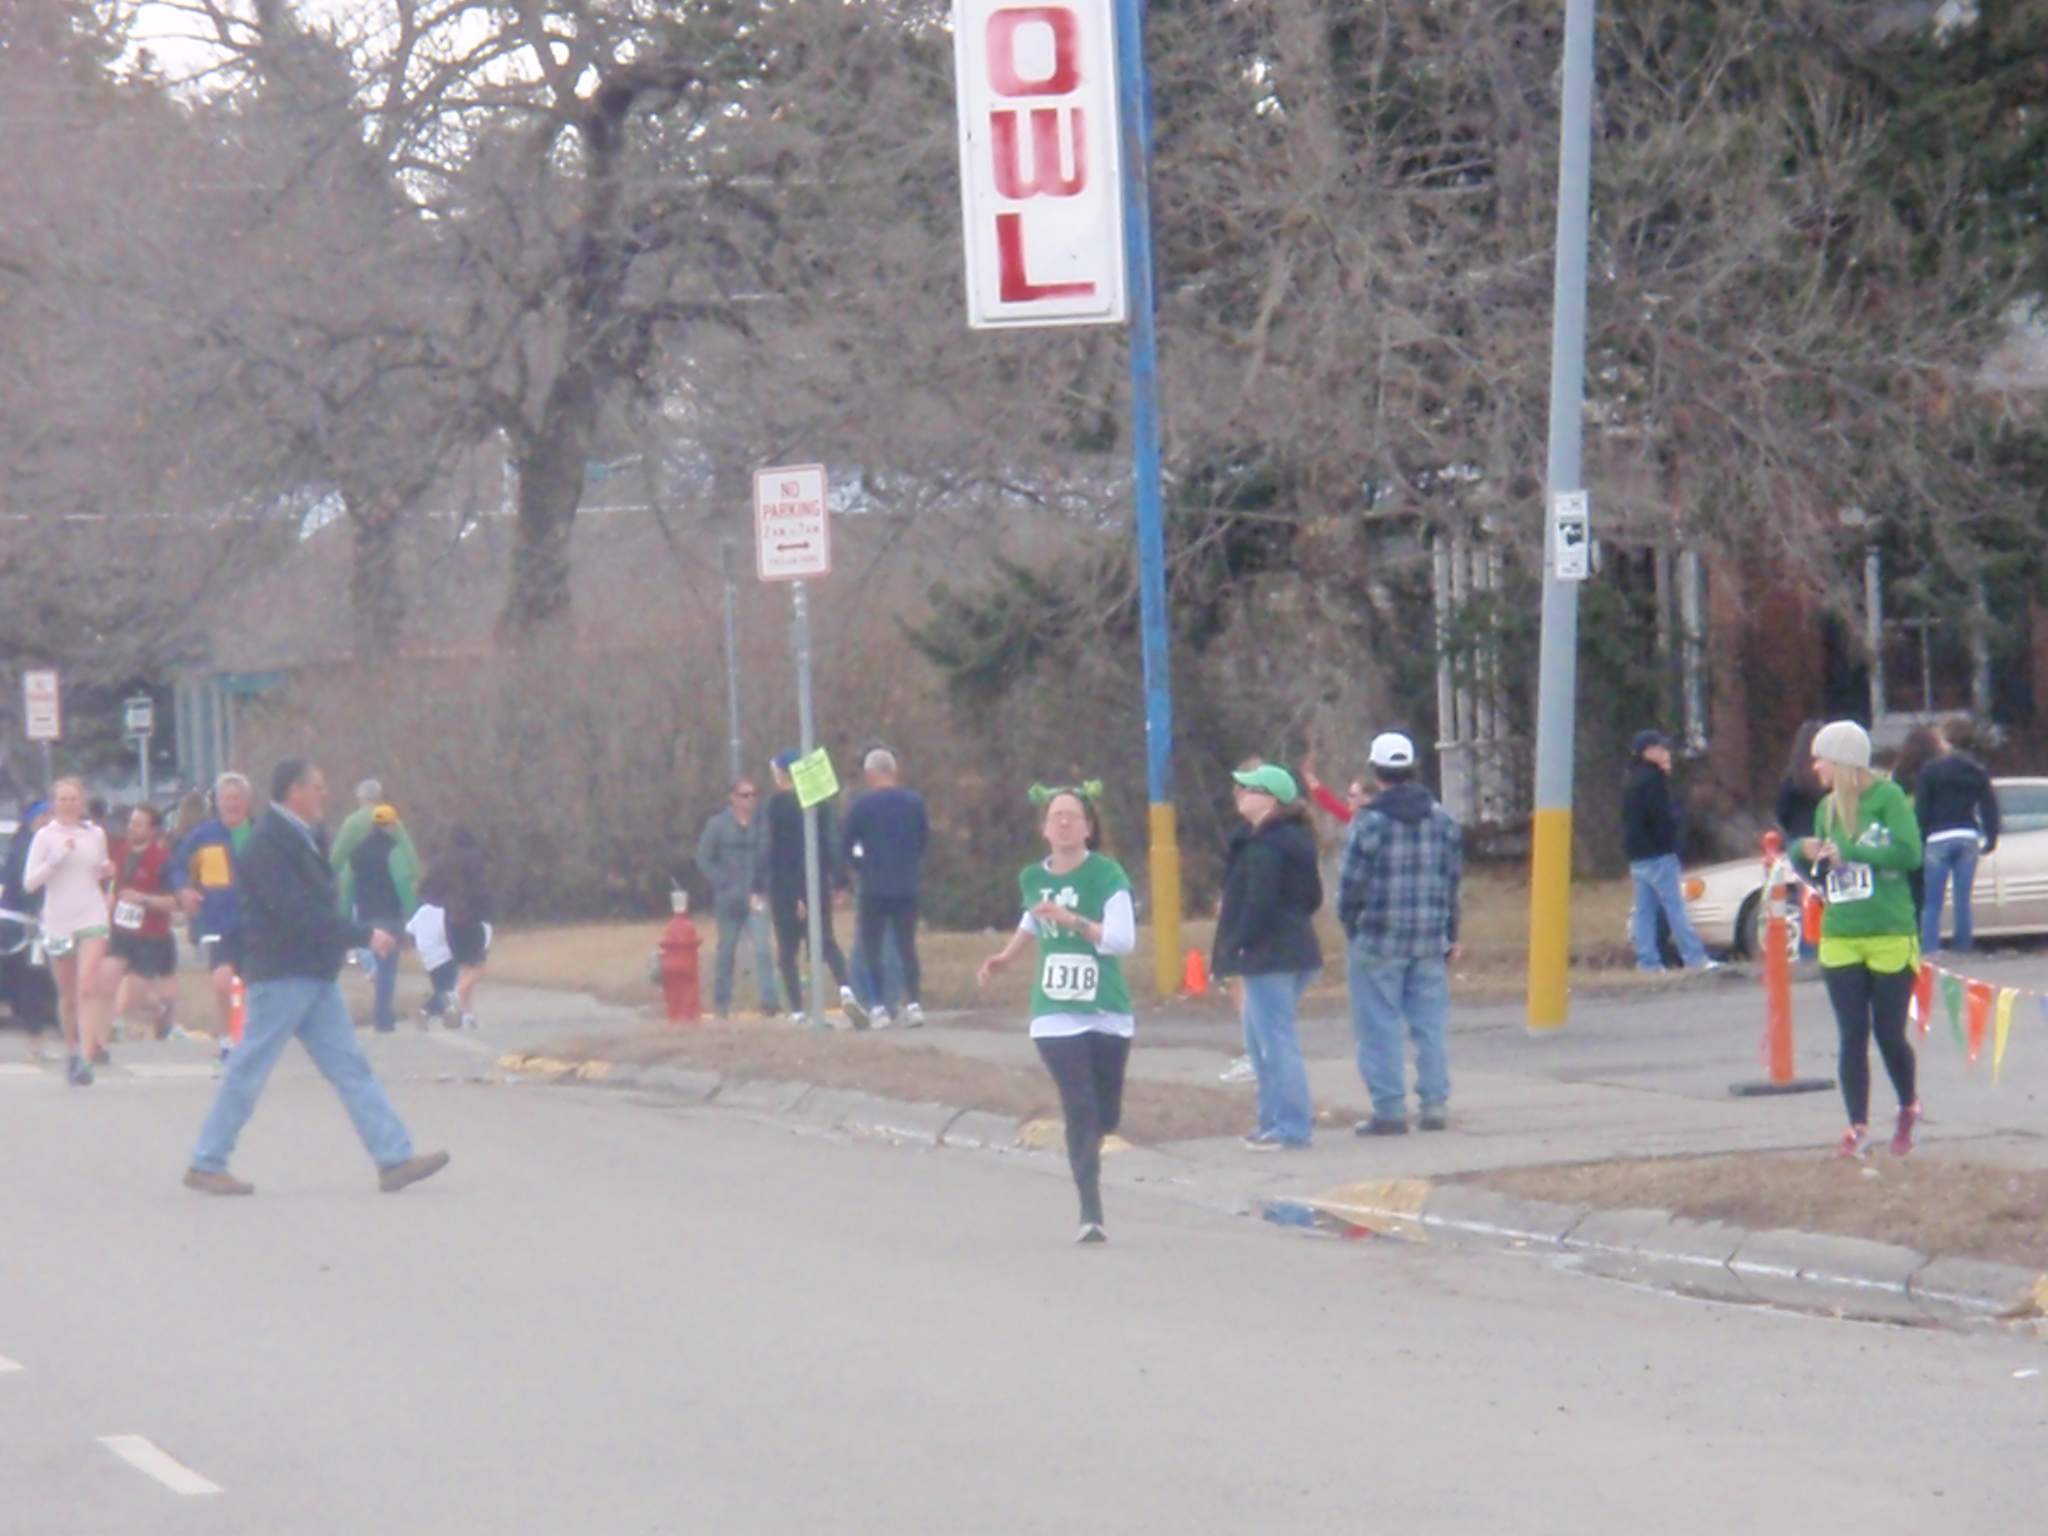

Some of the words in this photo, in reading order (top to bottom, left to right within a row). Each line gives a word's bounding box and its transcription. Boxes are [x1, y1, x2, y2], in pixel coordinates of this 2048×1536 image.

[985, 7, 1096, 303] OWL
[781, 481, 799, 498] NO
[763, 500, 820, 518] PARKING
[1046, 966, 1095, 989] 1318
